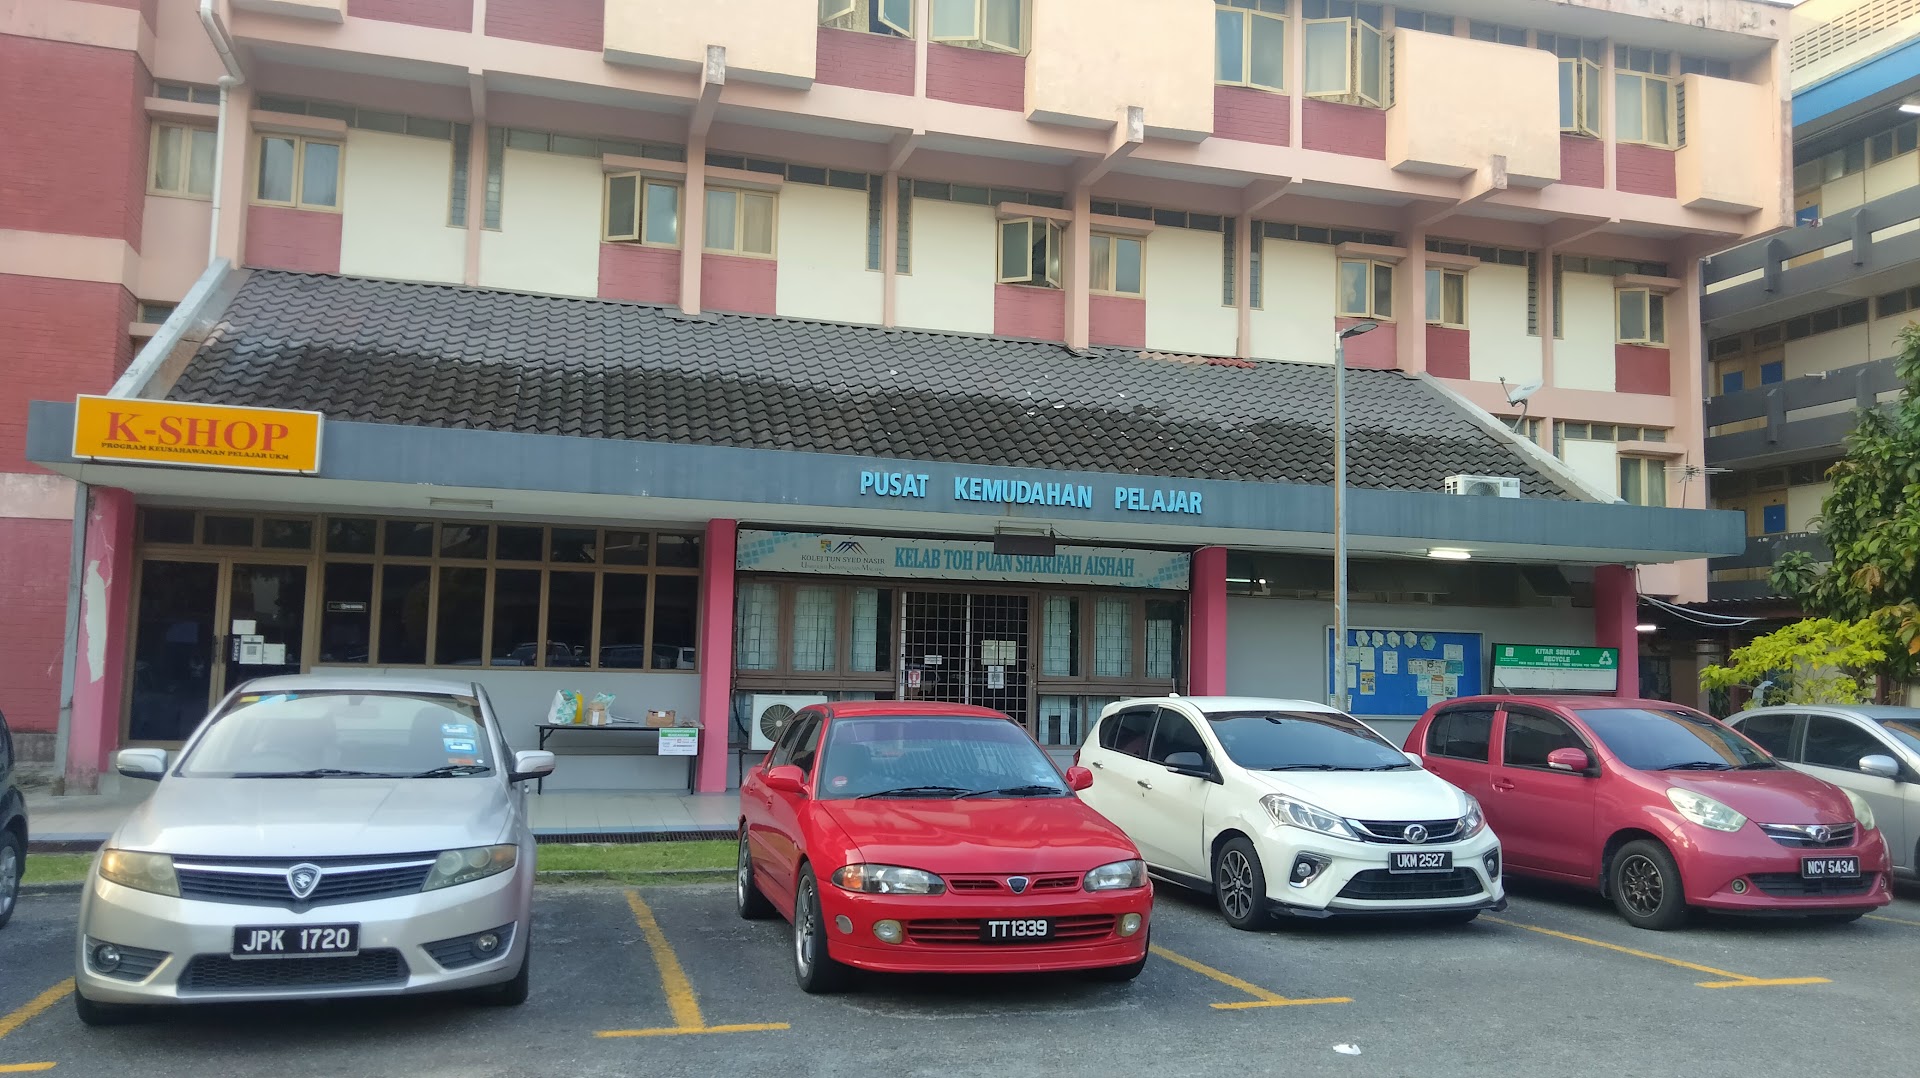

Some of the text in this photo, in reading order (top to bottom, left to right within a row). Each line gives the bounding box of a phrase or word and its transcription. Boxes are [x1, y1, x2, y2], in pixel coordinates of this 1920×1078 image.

[104, 411, 289, 452] K-SHOP
[101, 442, 147, 451] PROGRAM
[148, 445, 225, 456] KEUSAHAWANAN
[227, 451, 267, 459] PELAJAR
[860, 471, 1203, 514] PUSAT KEMUDAHAN PELAJAR
[894, 546, 941, 569] KELAB
[943, 548, 973, 571] TOH
[976, 550, 1012, 572] PUAN
[1015, 554, 1082, 575] SHARIFAH
[1084, 555, 1135, 578] AISHAH
[1555, 648, 1580, 656] SEMULA
[1397, 853, 1445, 867] UKM 2527
[1807, 860, 1855, 874] NCY 5434
[242, 928, 350, 951] JPK 1720
